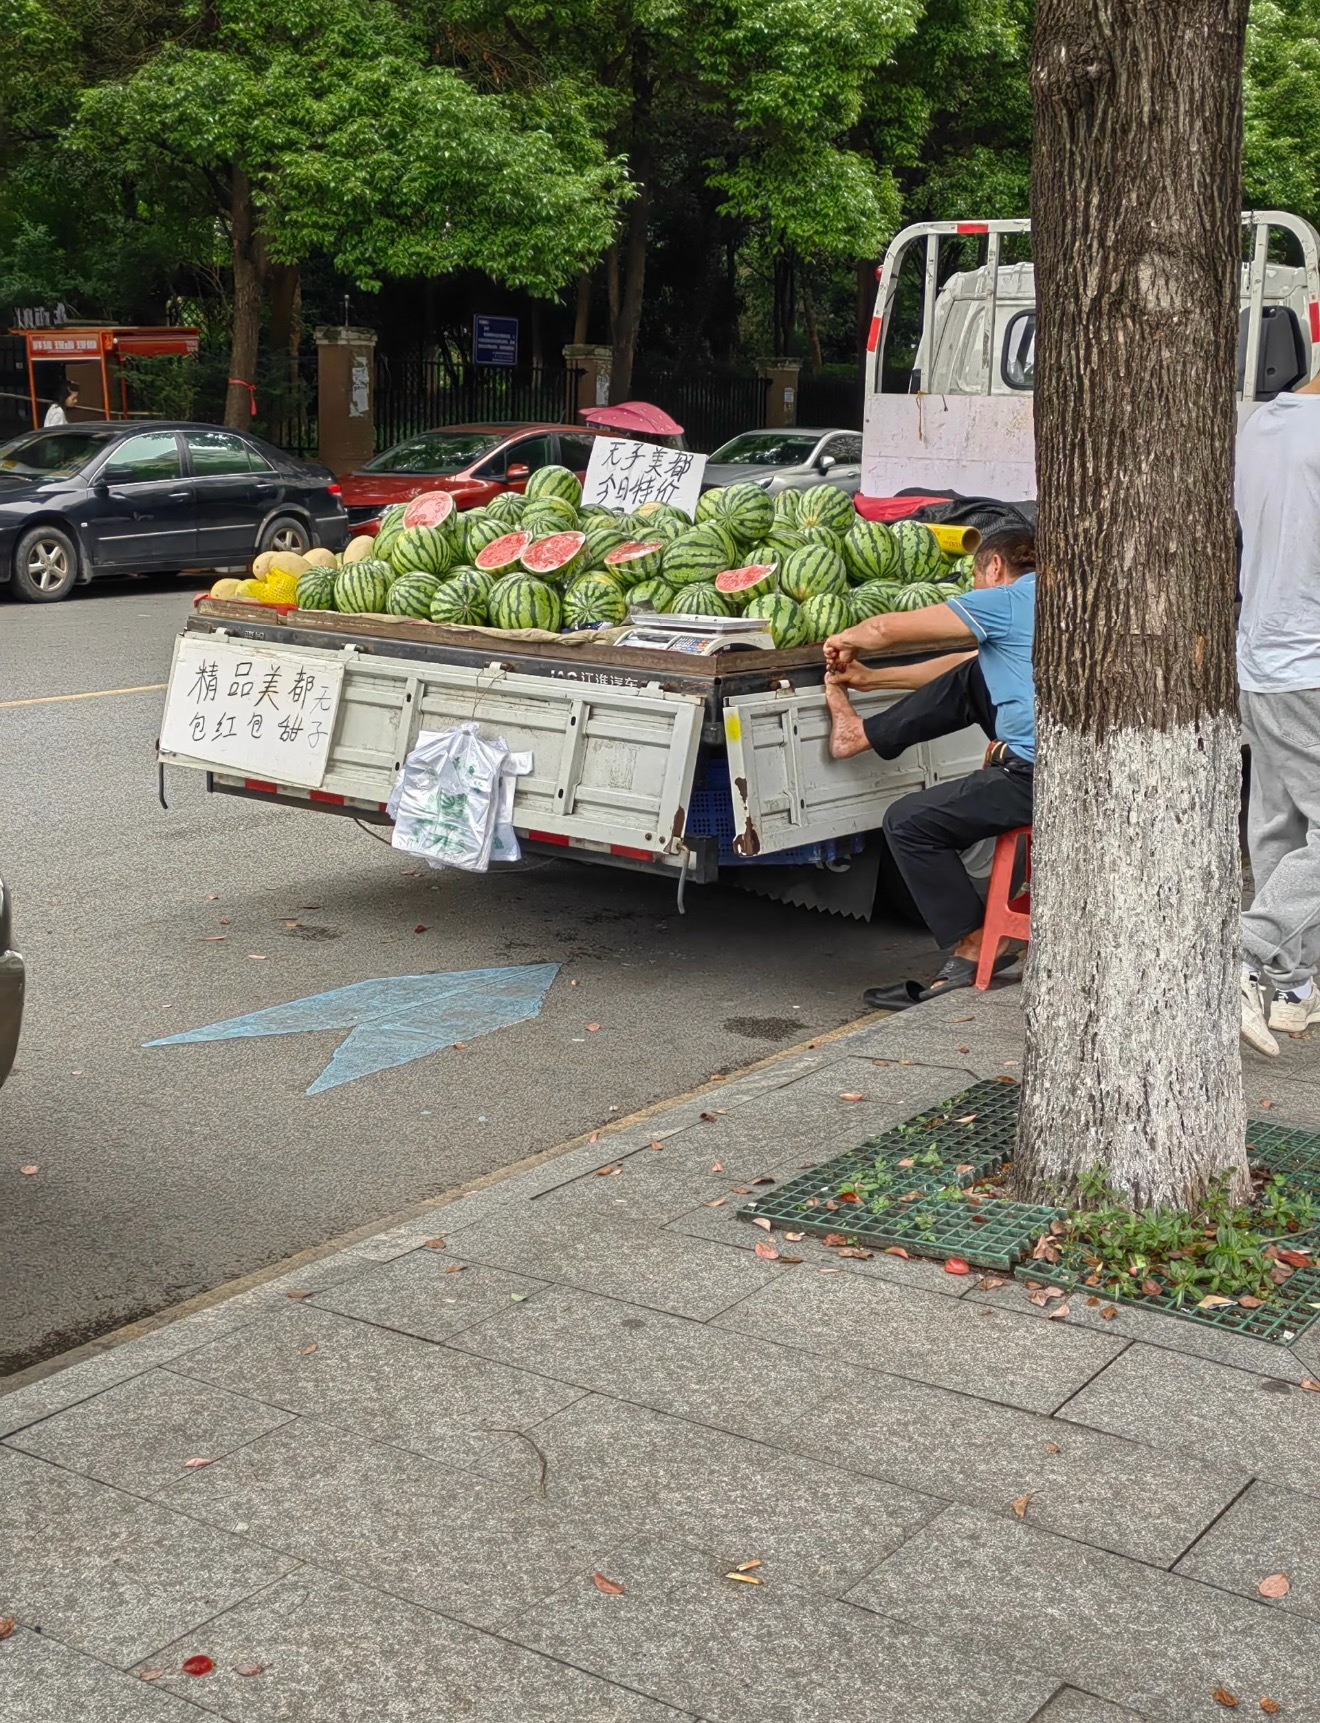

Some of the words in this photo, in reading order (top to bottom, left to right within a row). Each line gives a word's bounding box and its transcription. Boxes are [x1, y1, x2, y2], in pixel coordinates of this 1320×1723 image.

[596, 473, 680, 504] 今日特价
[581, 671, 639, 688] 江淮汽车
